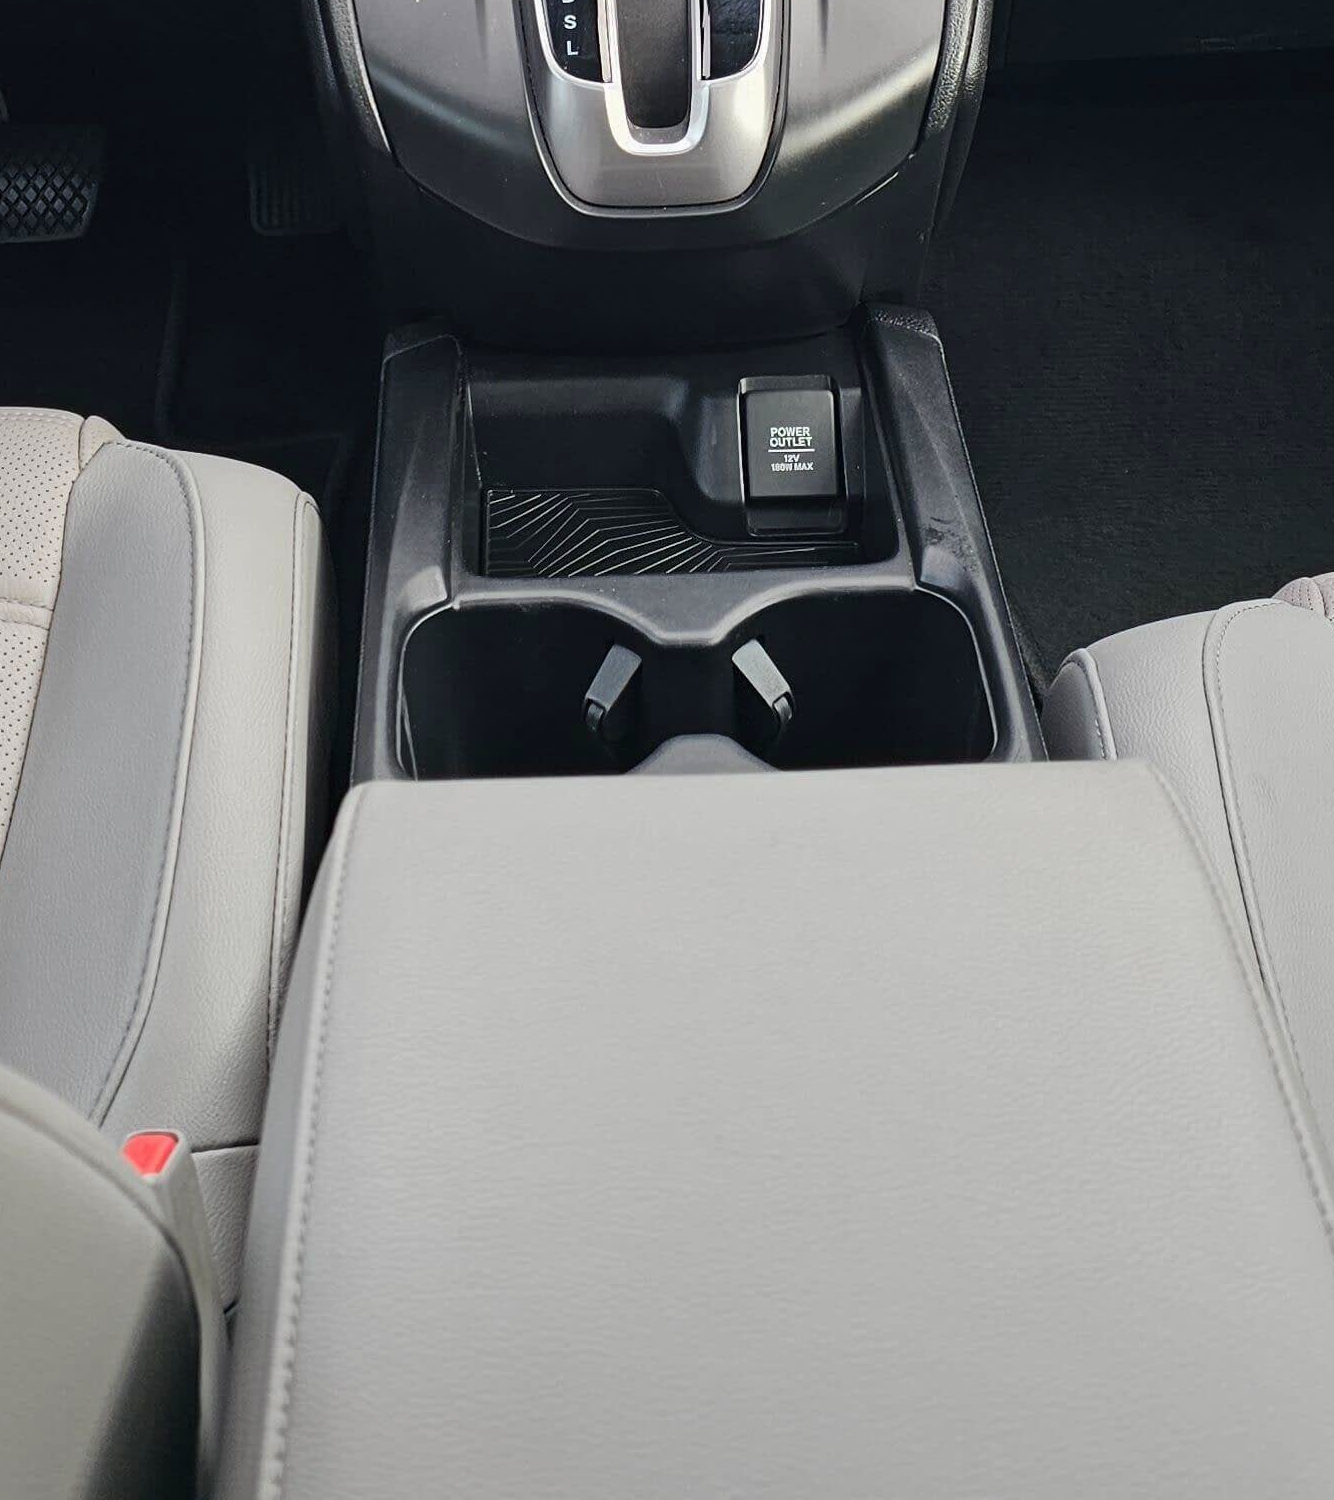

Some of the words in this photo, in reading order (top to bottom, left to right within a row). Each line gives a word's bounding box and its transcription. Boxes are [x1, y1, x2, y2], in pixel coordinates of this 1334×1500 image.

[564, 14, 577, 30] S
[566, 40, 579, 56] L
[770, 426, 811, 437] POWER
[769, 436, 813, 448] OUTLET
[783, 454, 800, 463] 12V
[794, 461, 814, 471] MAX
